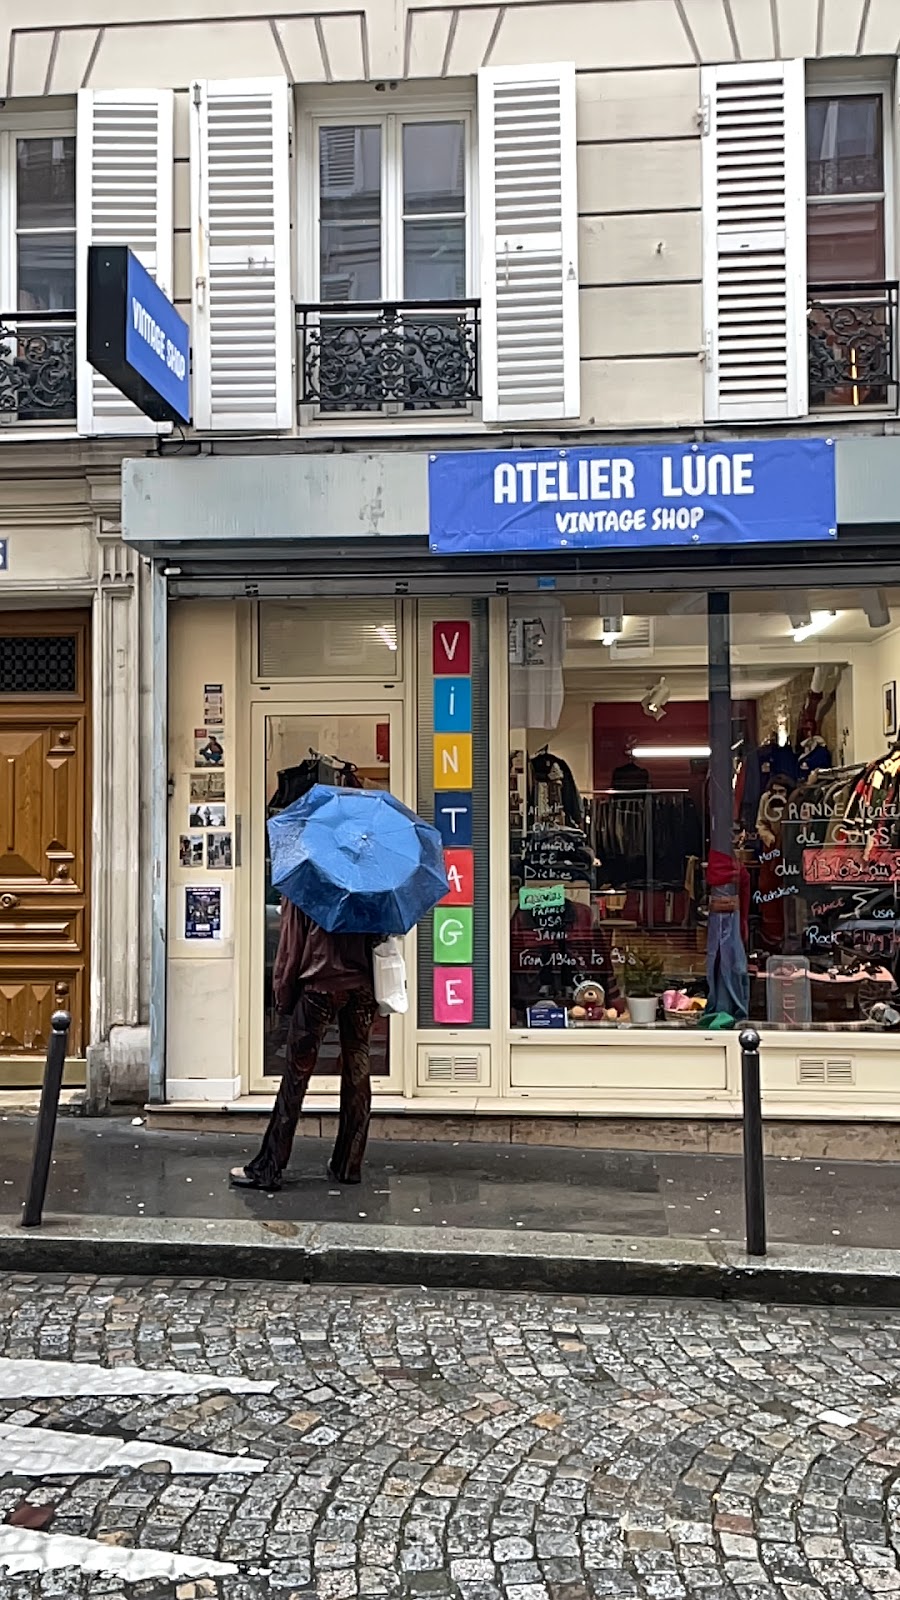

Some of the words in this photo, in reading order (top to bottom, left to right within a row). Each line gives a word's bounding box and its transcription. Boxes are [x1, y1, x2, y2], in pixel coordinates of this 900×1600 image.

[132, 297, 166, 361] VINTAGE
[166, 339, 186, 381] SHOP
[494, 458, 635, 504] ATELIER
[662, 453, 755, 497] LUNE
[556, 509, 646, 534] VINTAGE
[652, 507, 704, 530] SHOP
[796, 826, 820, 844] de
[530, 852, 558, 865] LEE
[774, 858, 800, 877] du
[524, 865, 573, 880] Dickies
[539, 915, 563, 927] USA
[872, 909, 896, 919] USA
[806, 925, 842, 945] Rock
[590, 949, 604, 965] to
